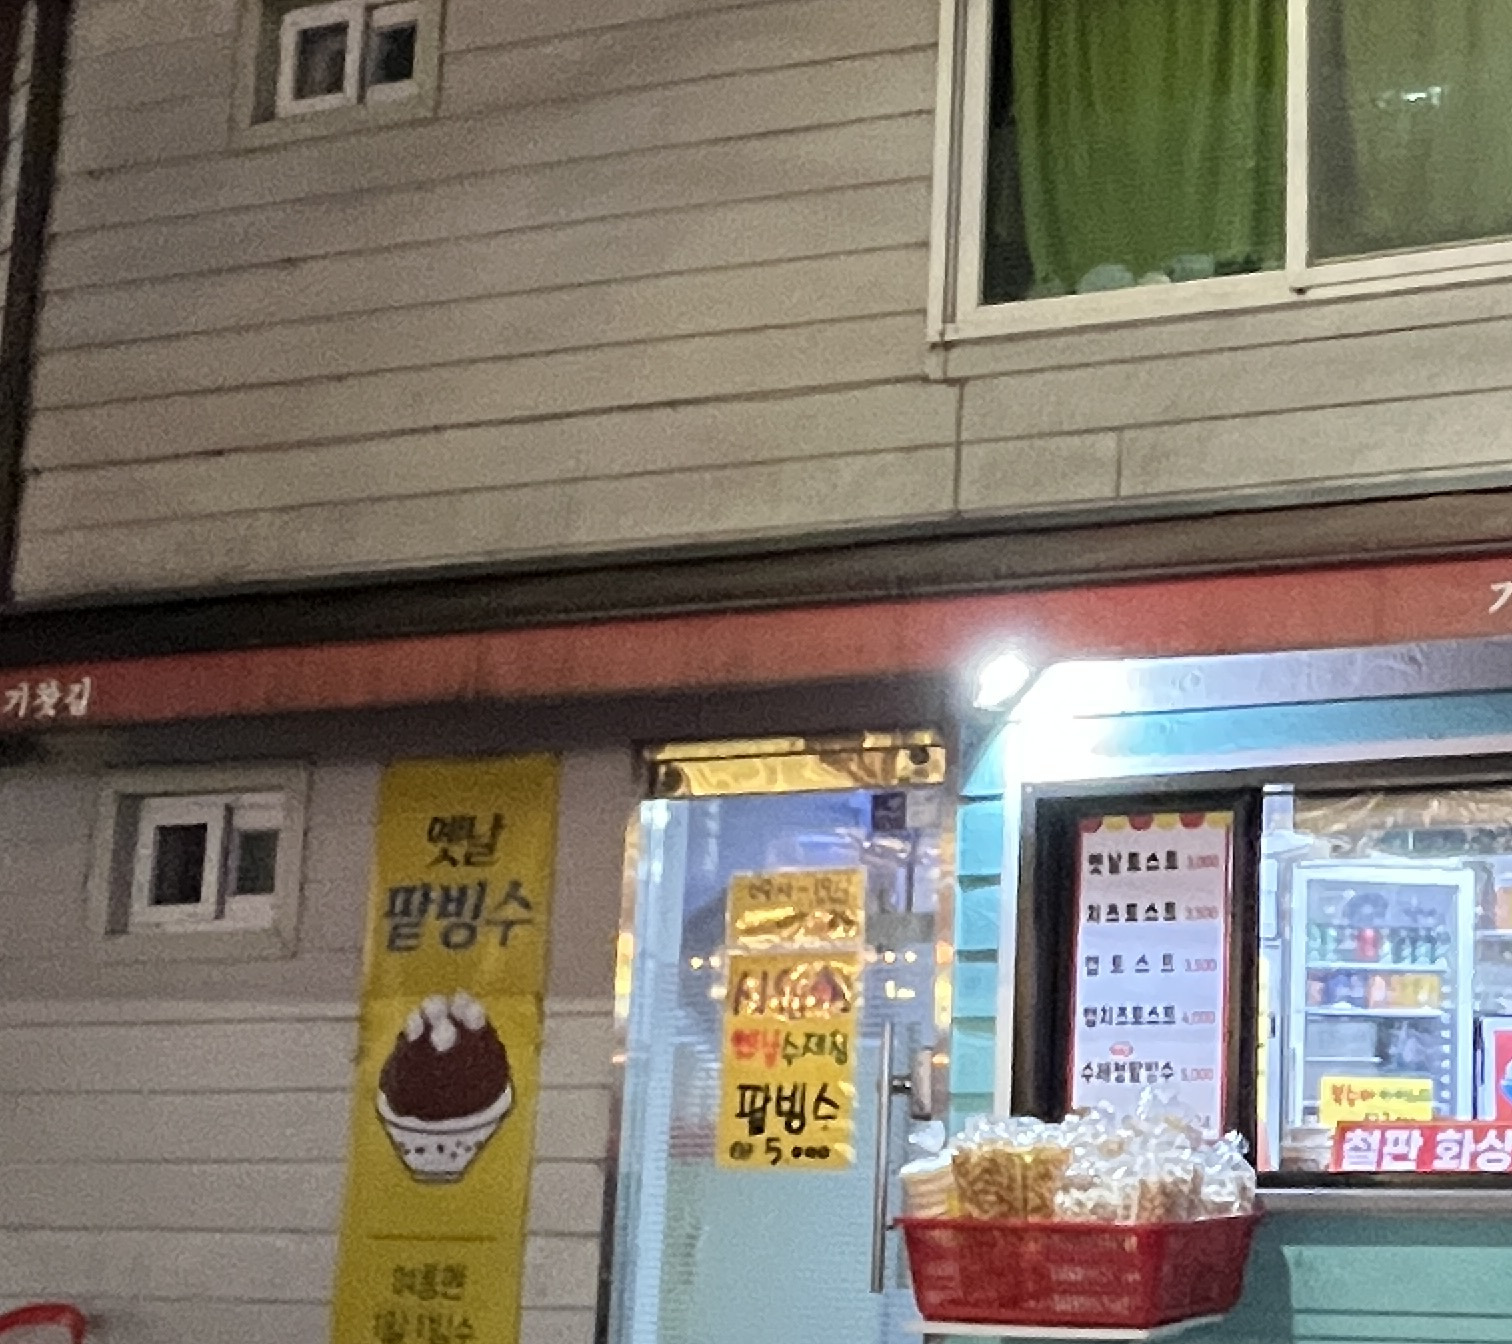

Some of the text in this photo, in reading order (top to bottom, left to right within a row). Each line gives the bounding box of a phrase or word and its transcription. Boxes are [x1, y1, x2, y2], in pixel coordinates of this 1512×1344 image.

[2, 676, 92, 718] 기찻길
[425, 813, 505, 867] 옛날
[383, 877, 533, 952] 팥빙수
[1341, 1128, 1424, 1172] 철판
